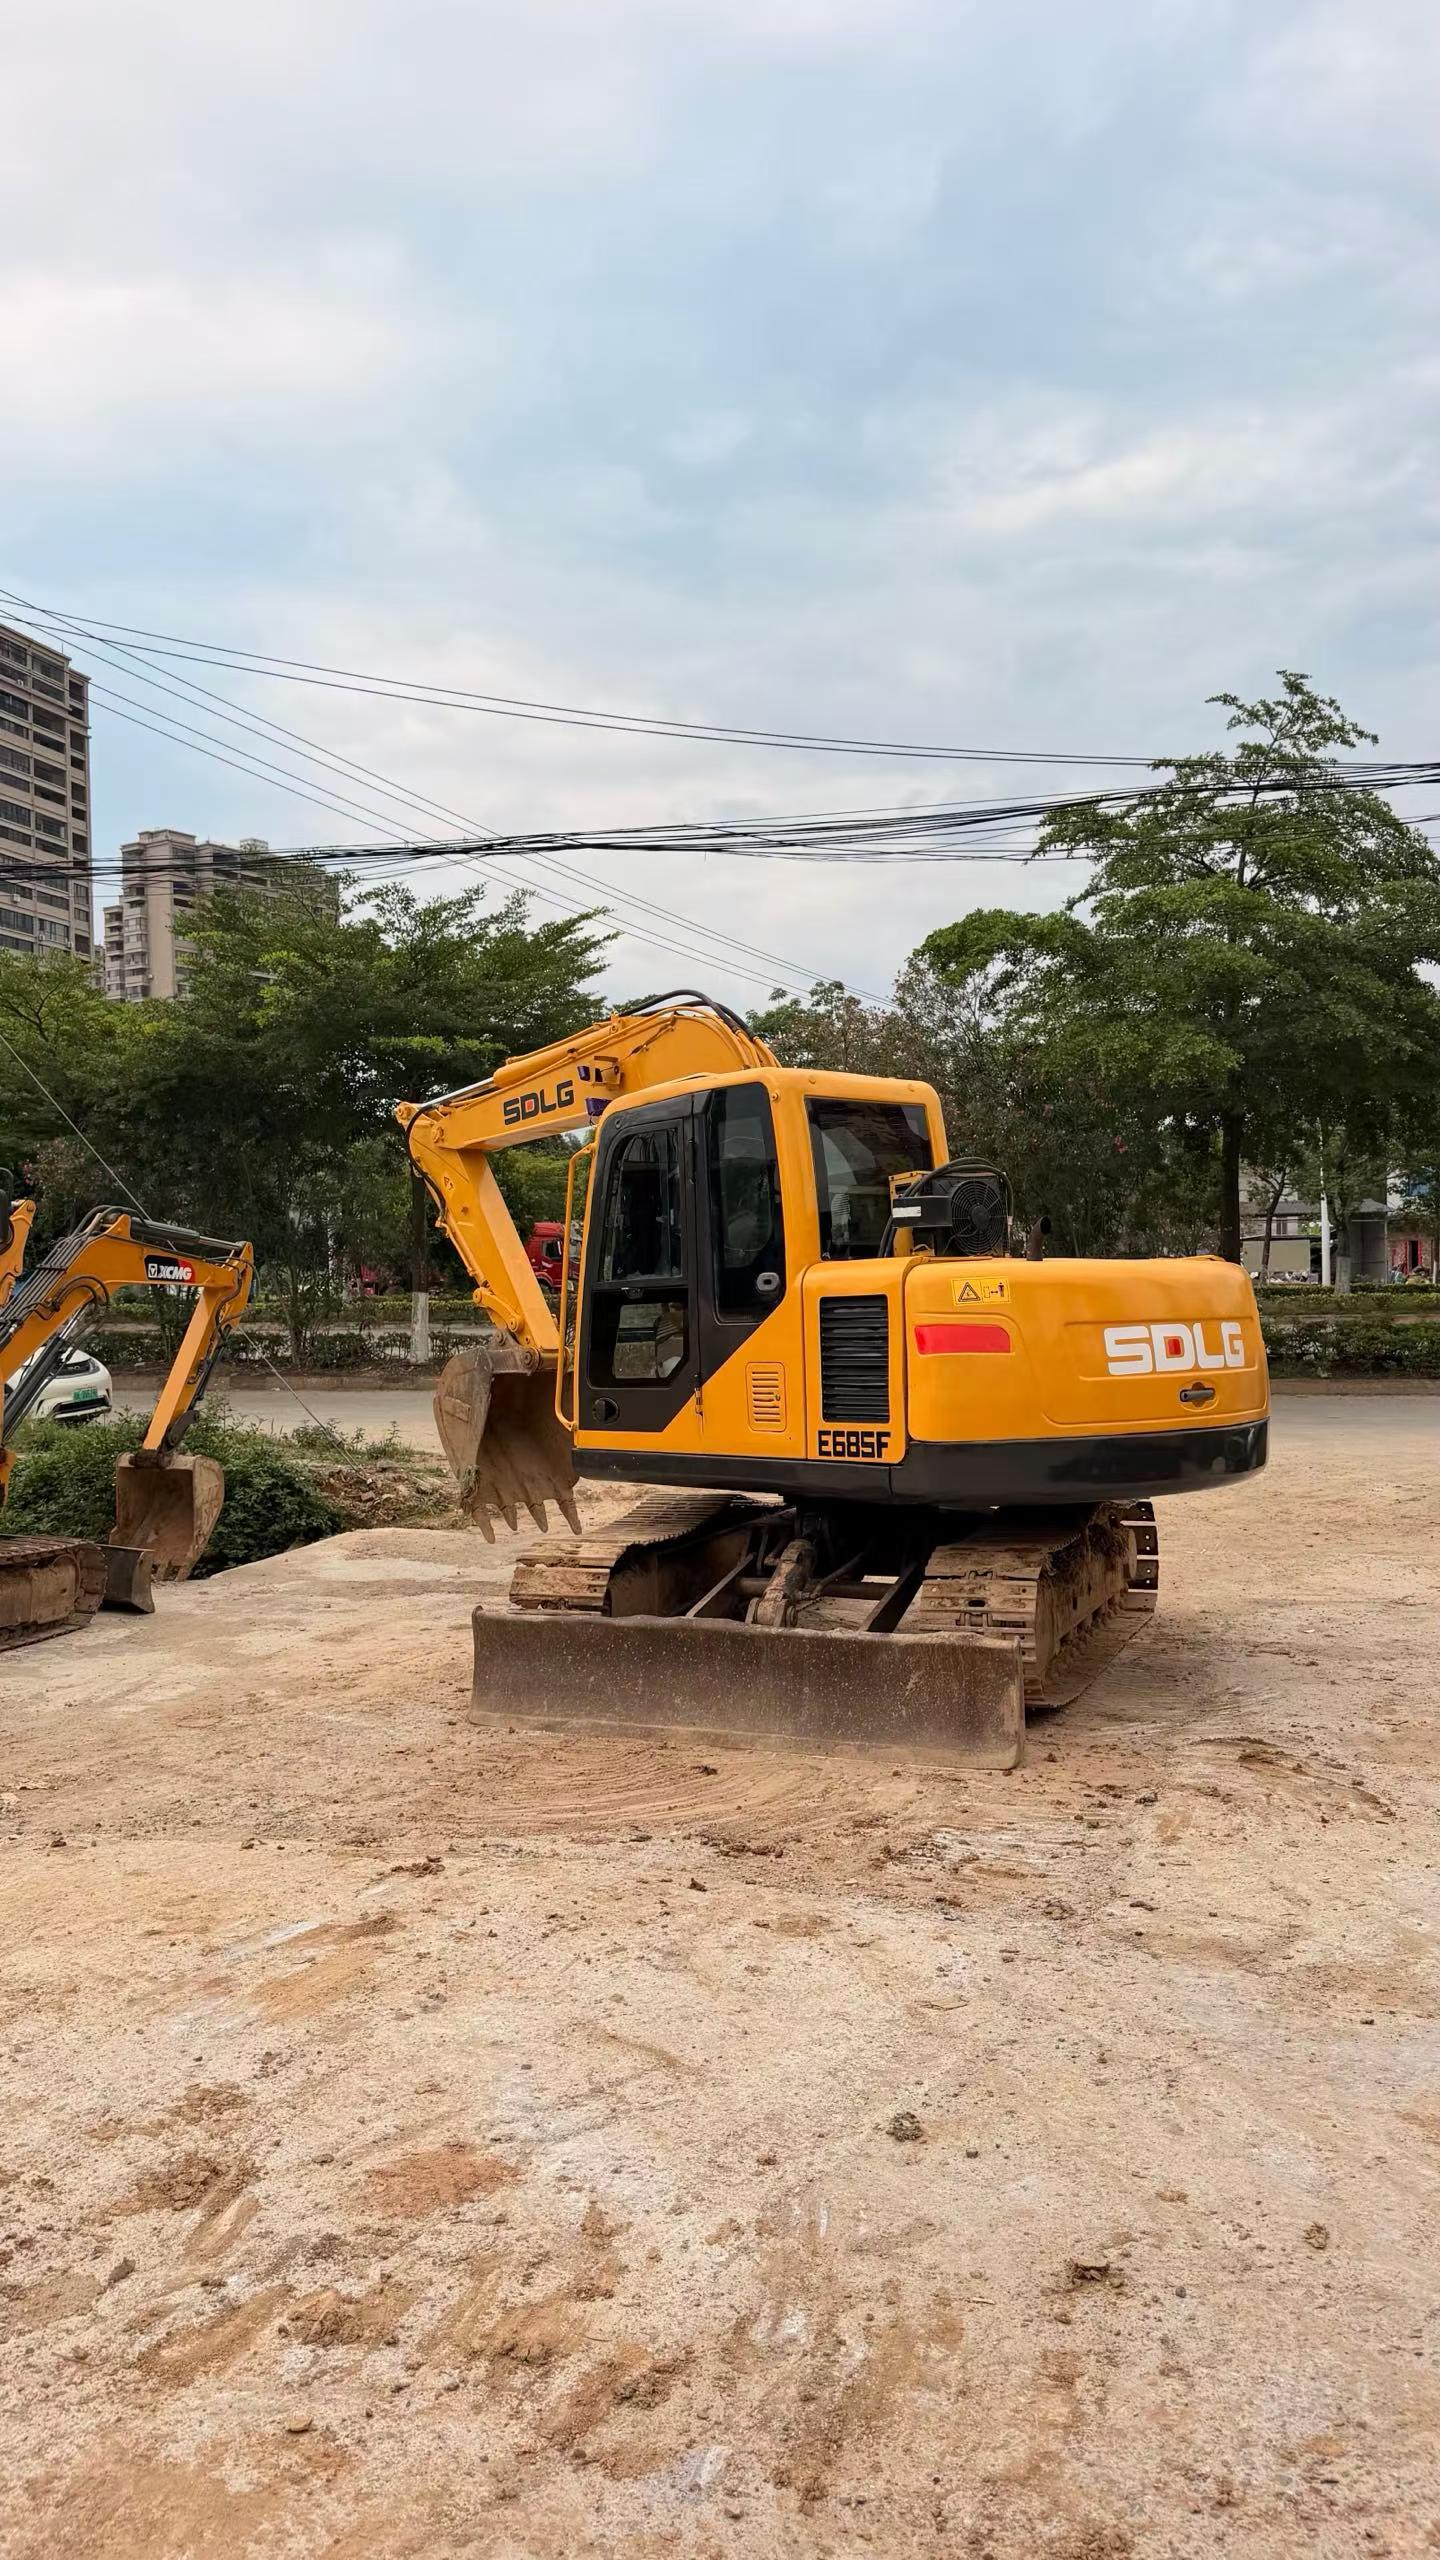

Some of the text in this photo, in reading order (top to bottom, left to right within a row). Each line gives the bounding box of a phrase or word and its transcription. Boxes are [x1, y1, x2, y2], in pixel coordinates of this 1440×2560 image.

[503, 1080, 575, 1126] SDLG
[158, 1265, 193, 1280] XCMG
[1104, 1322, 1245, 1376] SDLG
[818, 1430, 891, 1458] E685F
